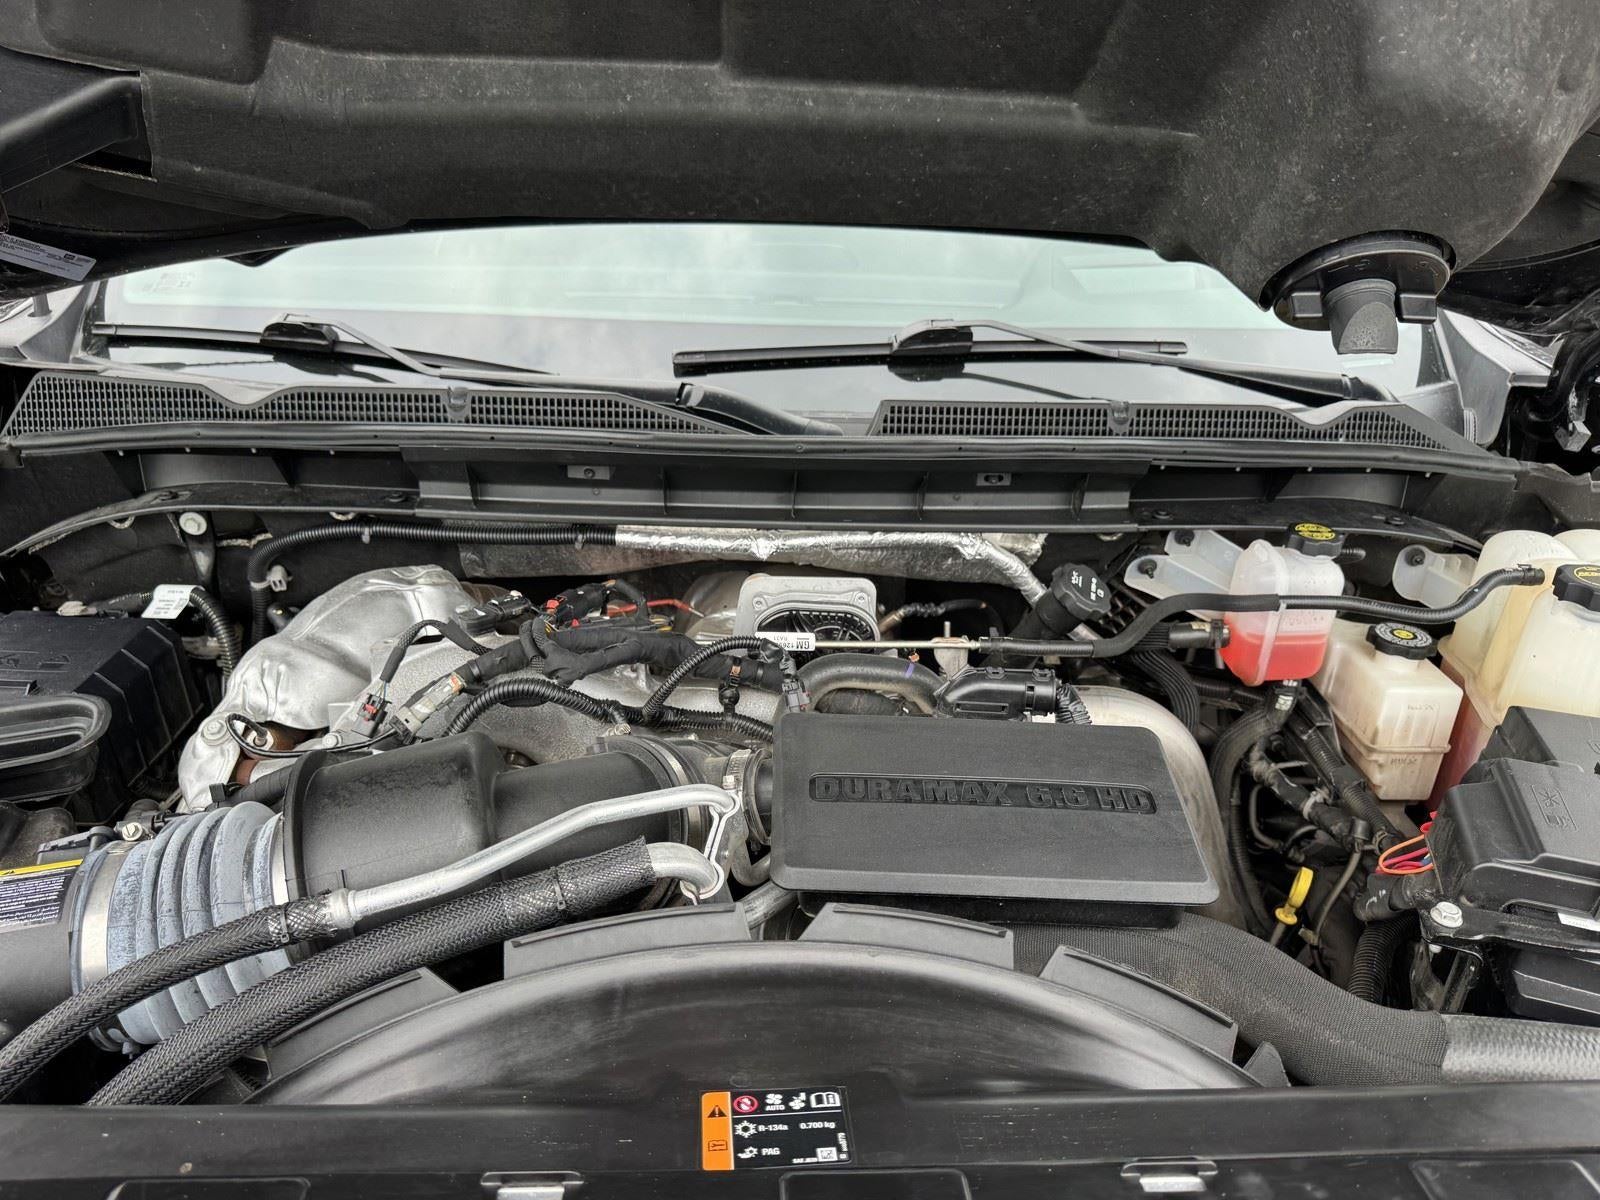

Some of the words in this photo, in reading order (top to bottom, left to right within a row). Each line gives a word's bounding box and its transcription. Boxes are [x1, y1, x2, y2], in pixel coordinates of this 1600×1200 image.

[796, 640, 810, 649] GM
[814, 776, 1014, 806] DURAMAX
[1026, 784, 1090, 809] 6.6
[1095, 786, 1153, 813] HD
[758, 1124, 789, 1132] R-134a
[824, 1121, 836, 1129] kg
[761, 1147, 780, 1155] PAG
